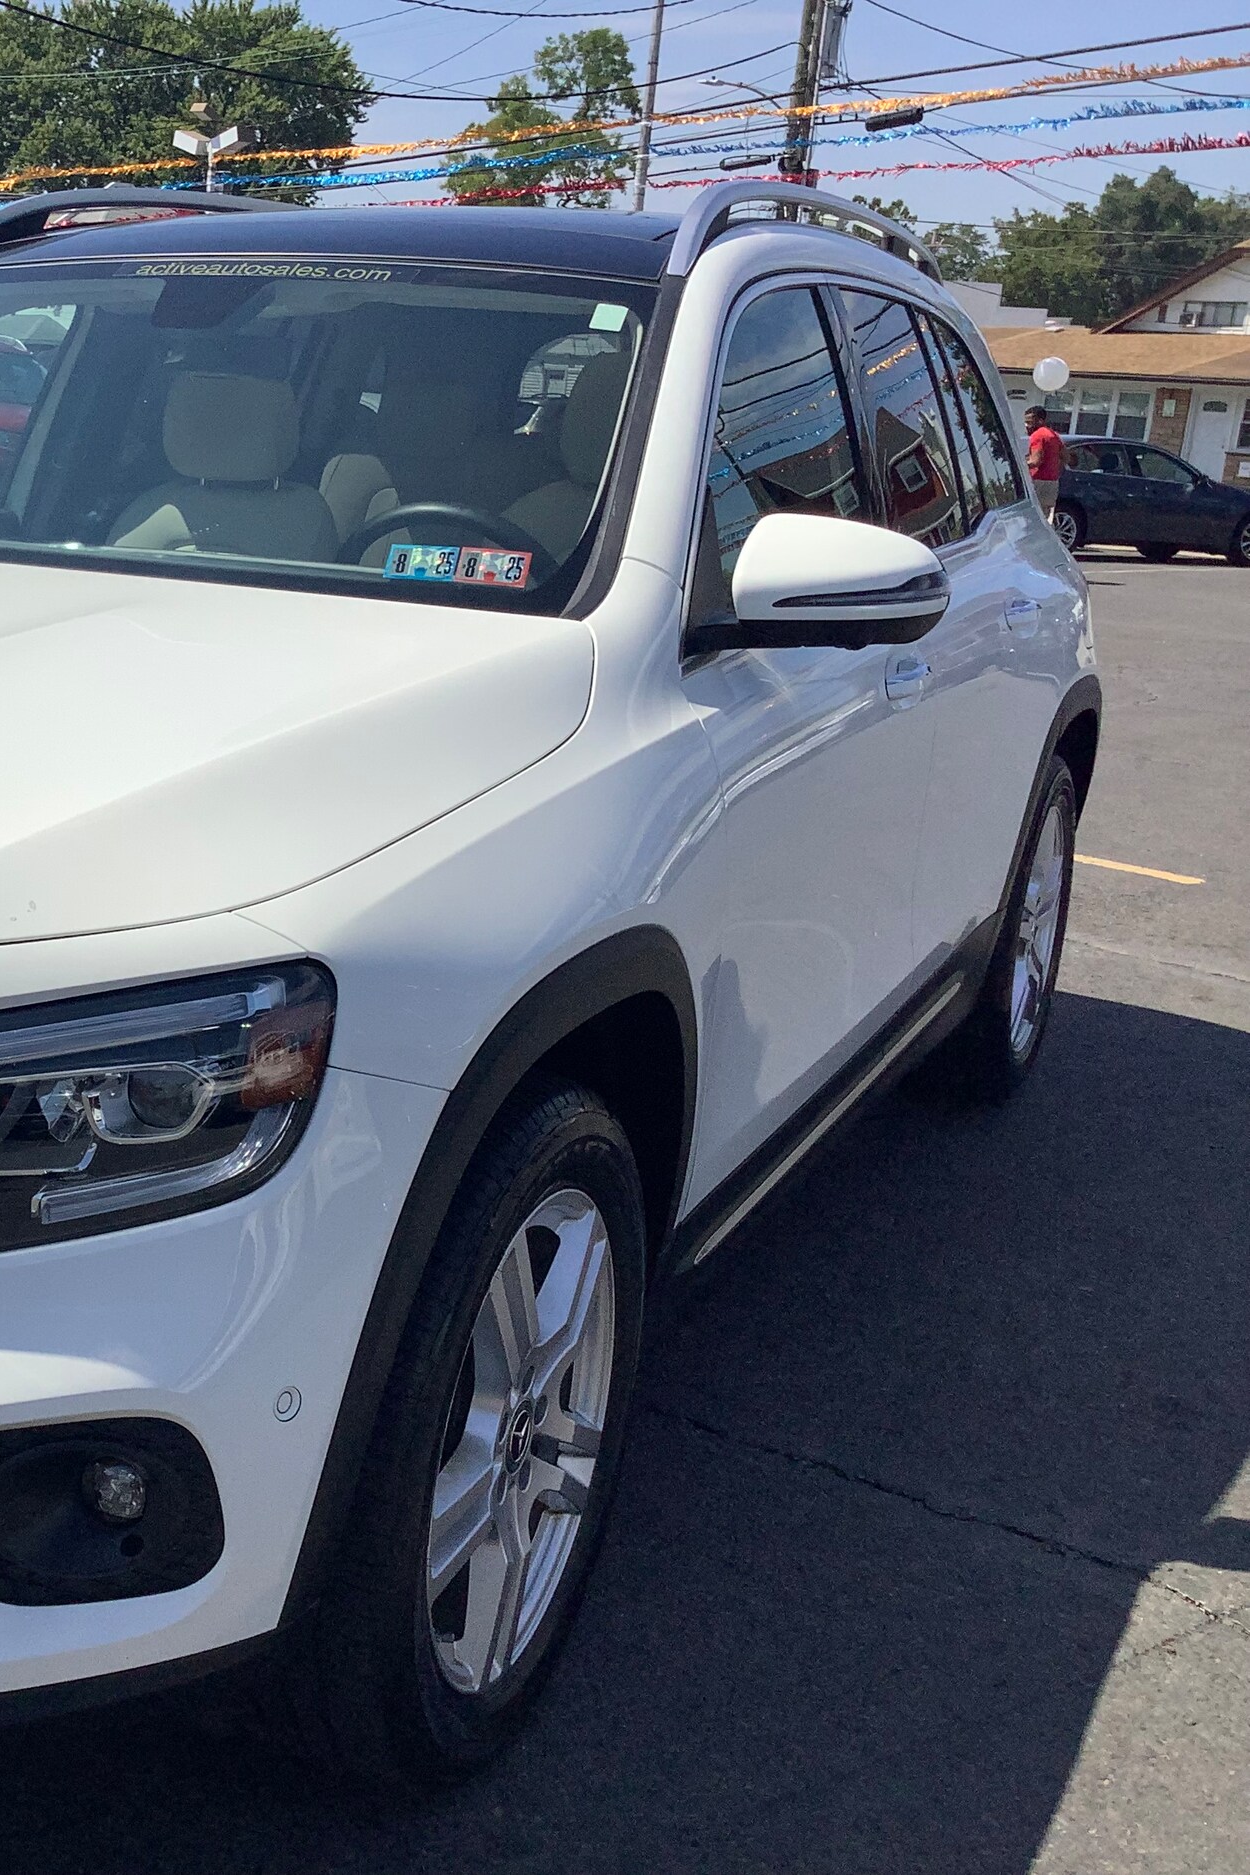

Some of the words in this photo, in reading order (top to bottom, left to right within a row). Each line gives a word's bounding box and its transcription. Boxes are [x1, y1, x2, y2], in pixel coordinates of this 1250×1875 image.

[135, 262, 392, 281] activeautosales.com
[395, 553, 407, 573] 8
[435, 551, 455, 575] 25
[464, 557, 478, 578] 8
[504, 556, 525, 581] 25
